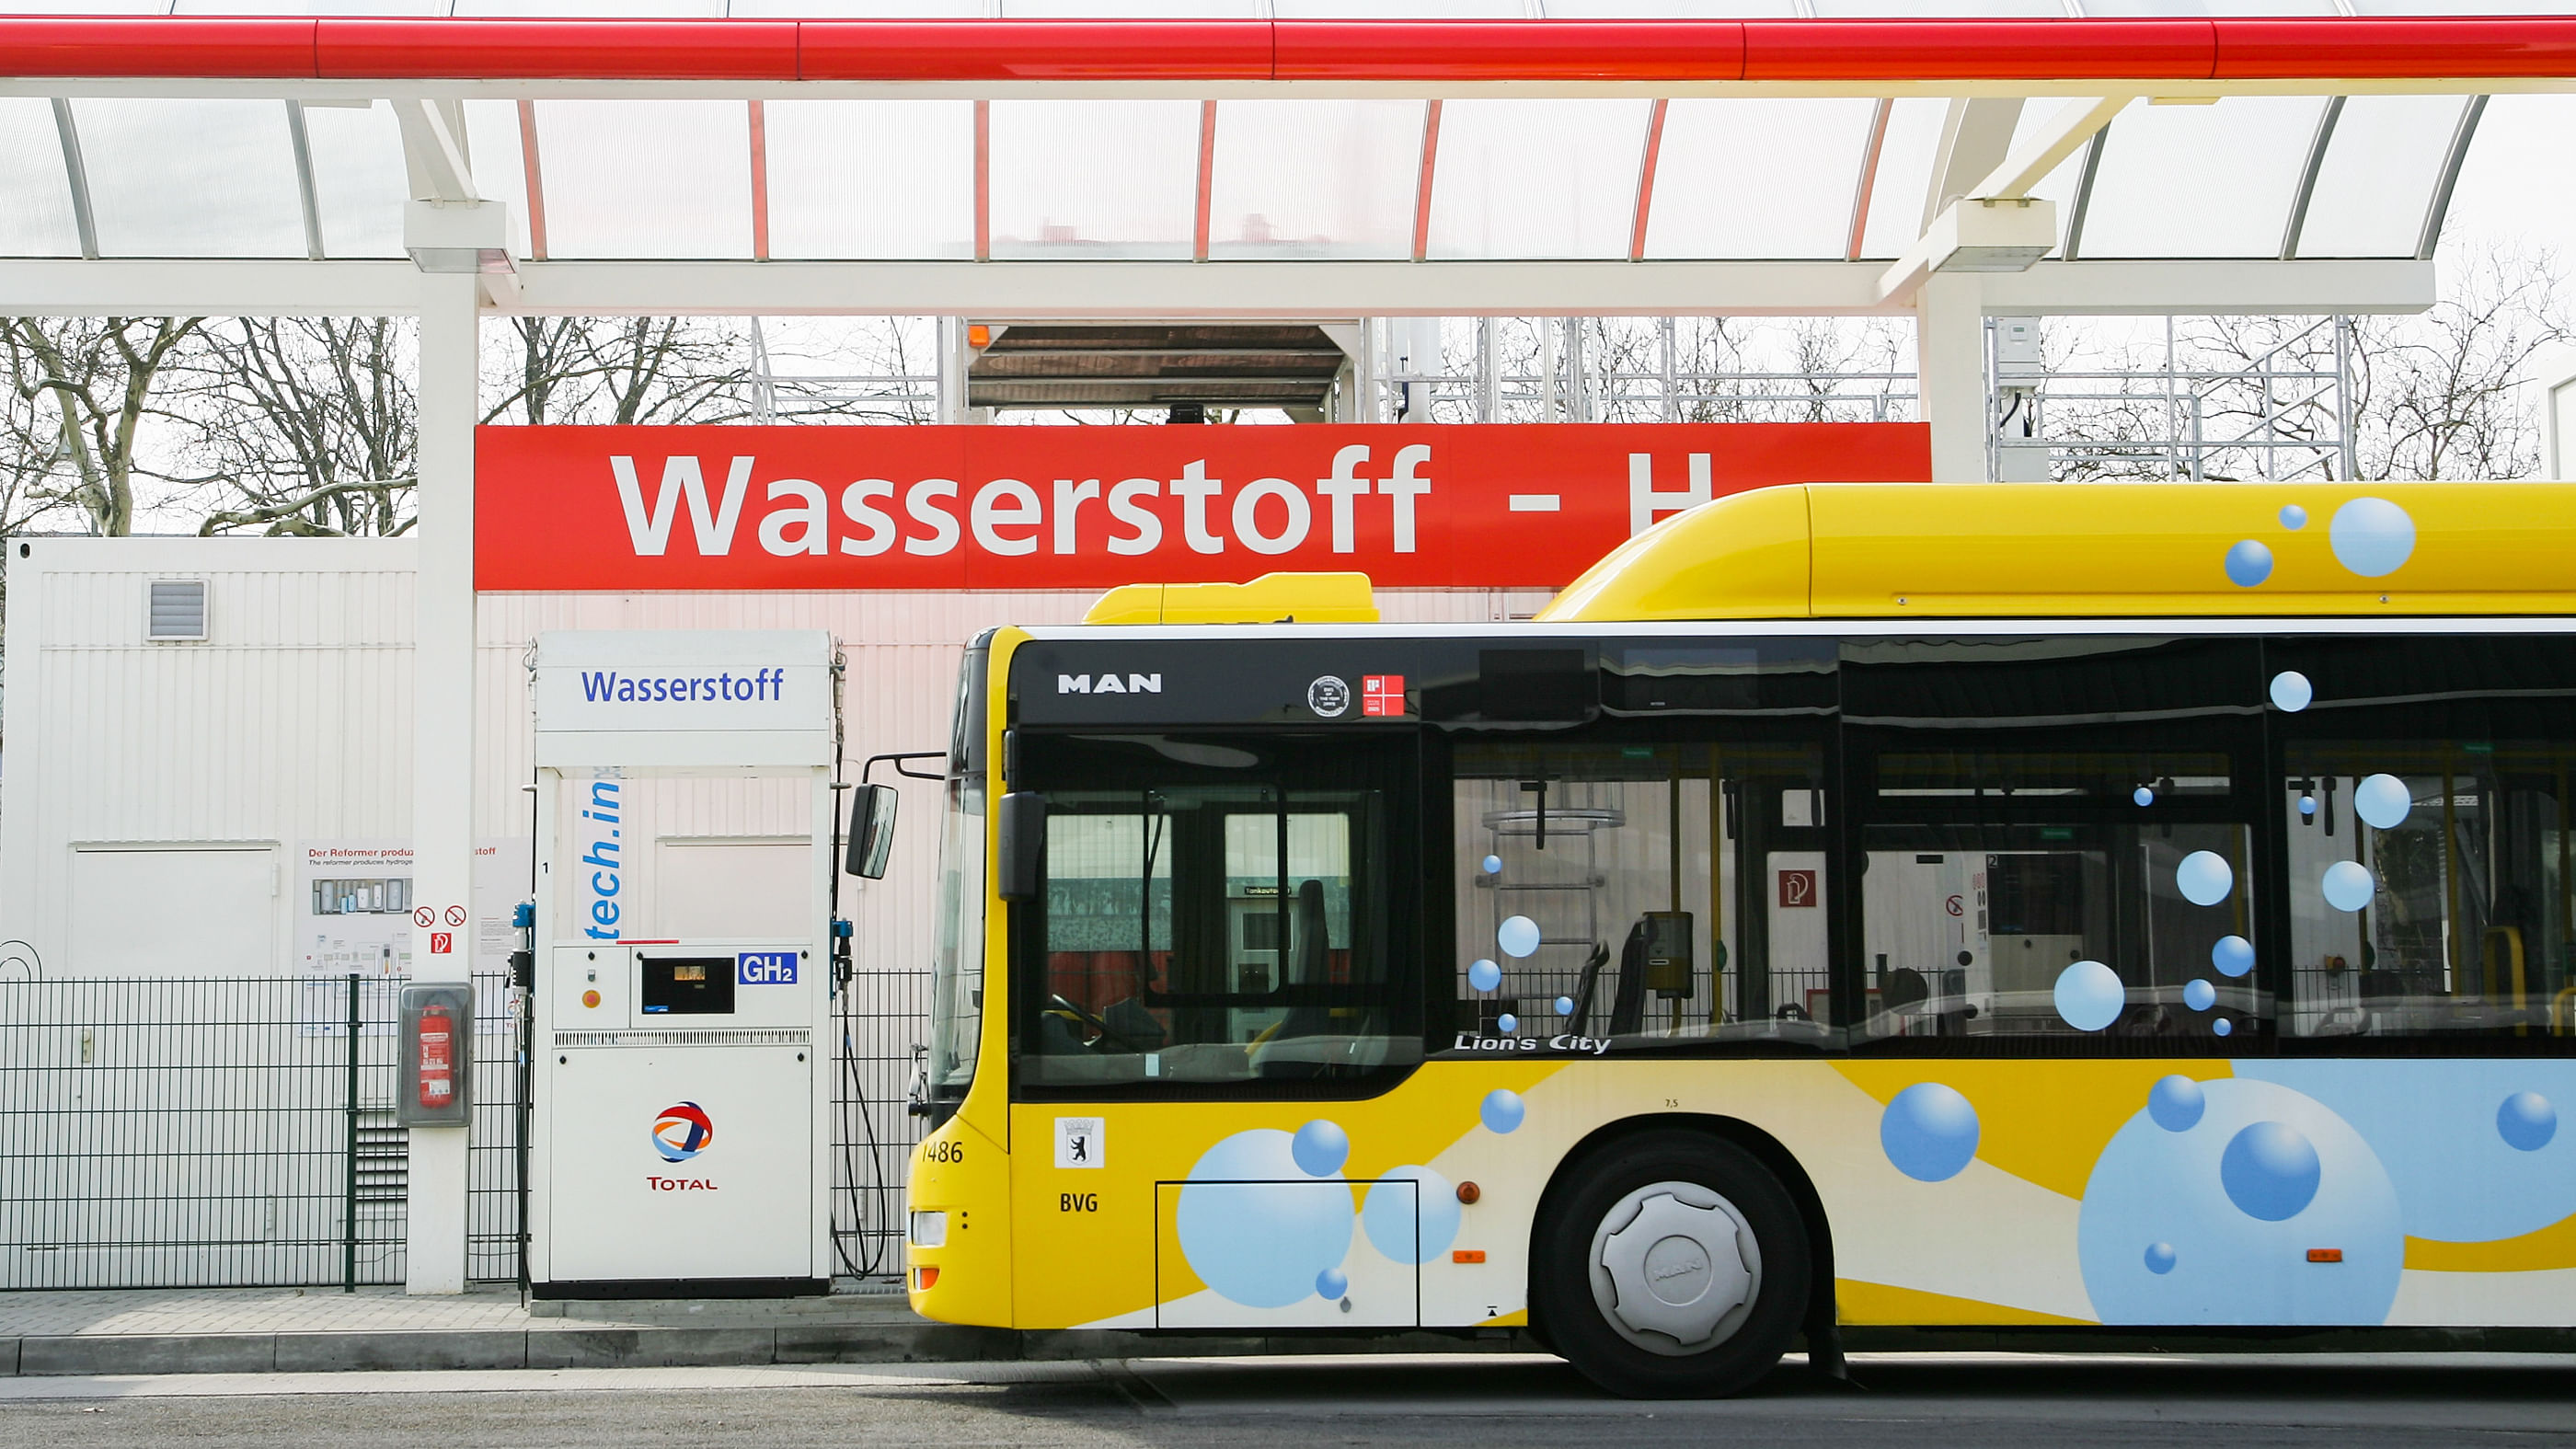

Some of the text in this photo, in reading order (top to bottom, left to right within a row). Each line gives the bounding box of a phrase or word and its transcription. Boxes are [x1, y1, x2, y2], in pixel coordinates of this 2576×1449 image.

[609, 443, 1432, 557] Wasserstoff
[1628, 453, 1712, 540] H
[582, 668, 784, 702] Wasserstoff
[1058, 673, 1162, 694] MAN
[308, 848, 327, 857] Der
[330, 848, 378, 857] Reformer
[475, 846, 496, 856] stoff
[542, 862, 548, 874] 1
[1988, 856, 1997, 868] 2
[1455, 1034, 1612, 1055] Lion's City
[922, 1141, 963, 1163] 1486
[647, 1176, 718, 1190] TOTAL
[1060, 1192, 1098, 1213] BVG
